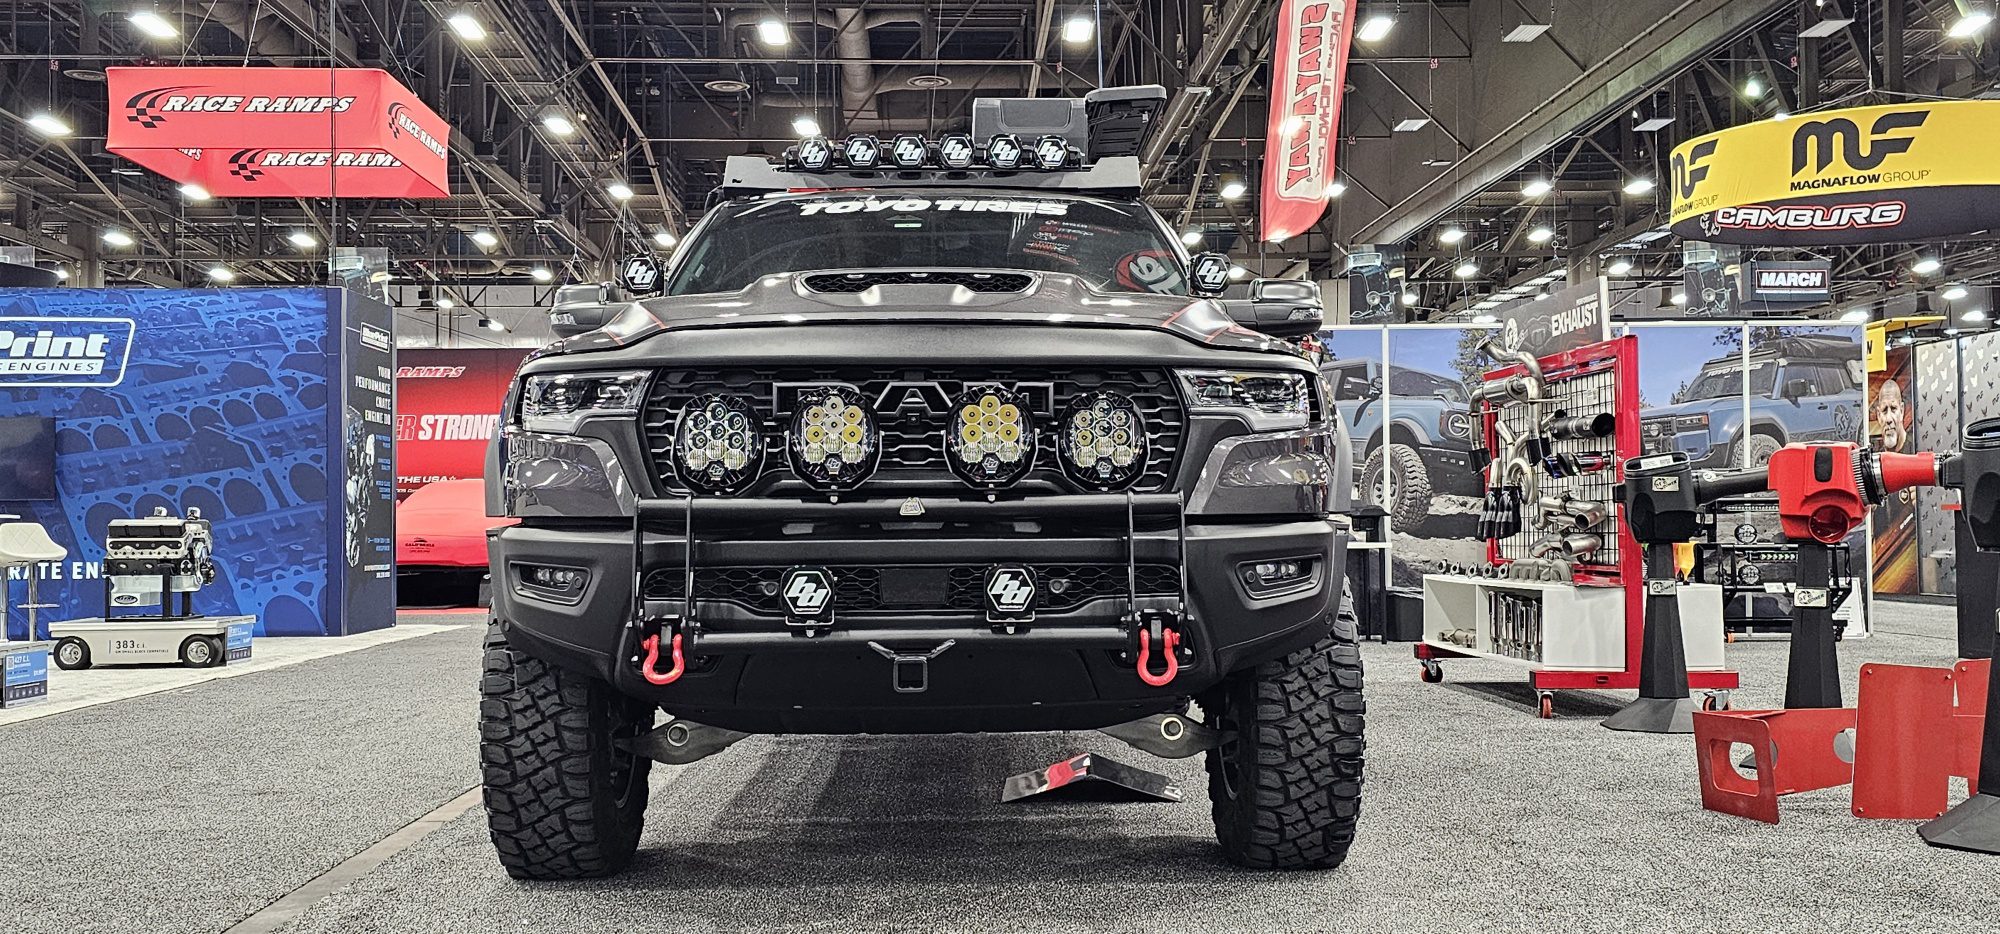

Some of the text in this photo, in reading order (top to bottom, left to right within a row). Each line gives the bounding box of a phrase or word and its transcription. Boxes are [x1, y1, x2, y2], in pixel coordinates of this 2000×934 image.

[160, 96, 356, 112] RACE RAMPS
[398, 112, 445, 161] RACE RAMPS
[261, 152, 332, 168] RACE
[1790, 170, 1930, 192] MAGNAFLOW GROUP
[800, 200, 1068, 216] TOYO TIRES
[1694, 194, 1718, 209] GROUP
[1716, 204, 1903, 228] CAMBURG
[1761, 272, 1822, 287] MARCH
[1551, 301, 1599, 337] EXHAUST
[396, 366, 466, 378] RAMPS
[397, 475, 450, 484] THE USA
[115, 640, 135, 650] 383
